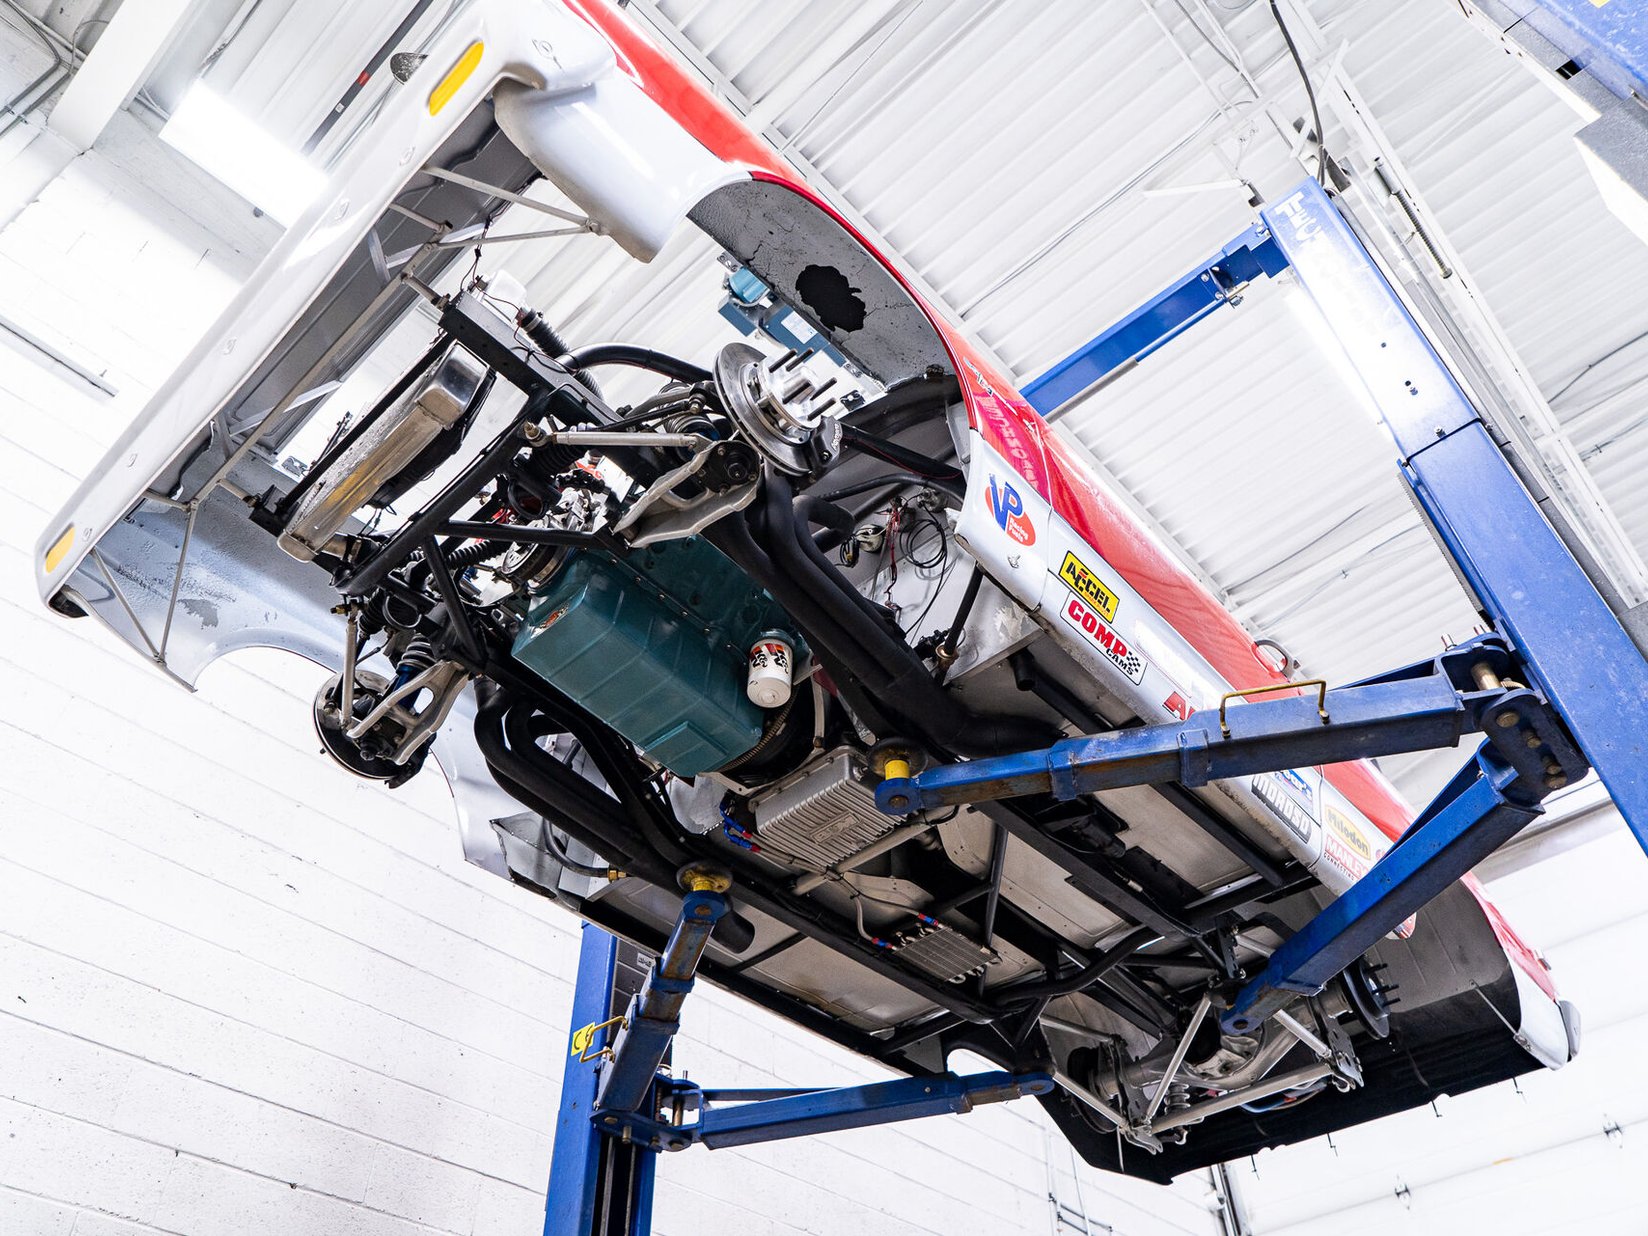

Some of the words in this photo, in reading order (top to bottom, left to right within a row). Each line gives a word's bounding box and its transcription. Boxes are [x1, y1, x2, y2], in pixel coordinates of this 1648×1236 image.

[987, 472, 1023, 532] VP
[1065, 561, 1111, 613] ACCEL
[1067, 599, 1127, 657] COMP
[1105, 647, 1134, 676] CAMS
[1327, 808, 1370, 857] Milodon
[1323, 852, 1356, 881] CONNECTING
